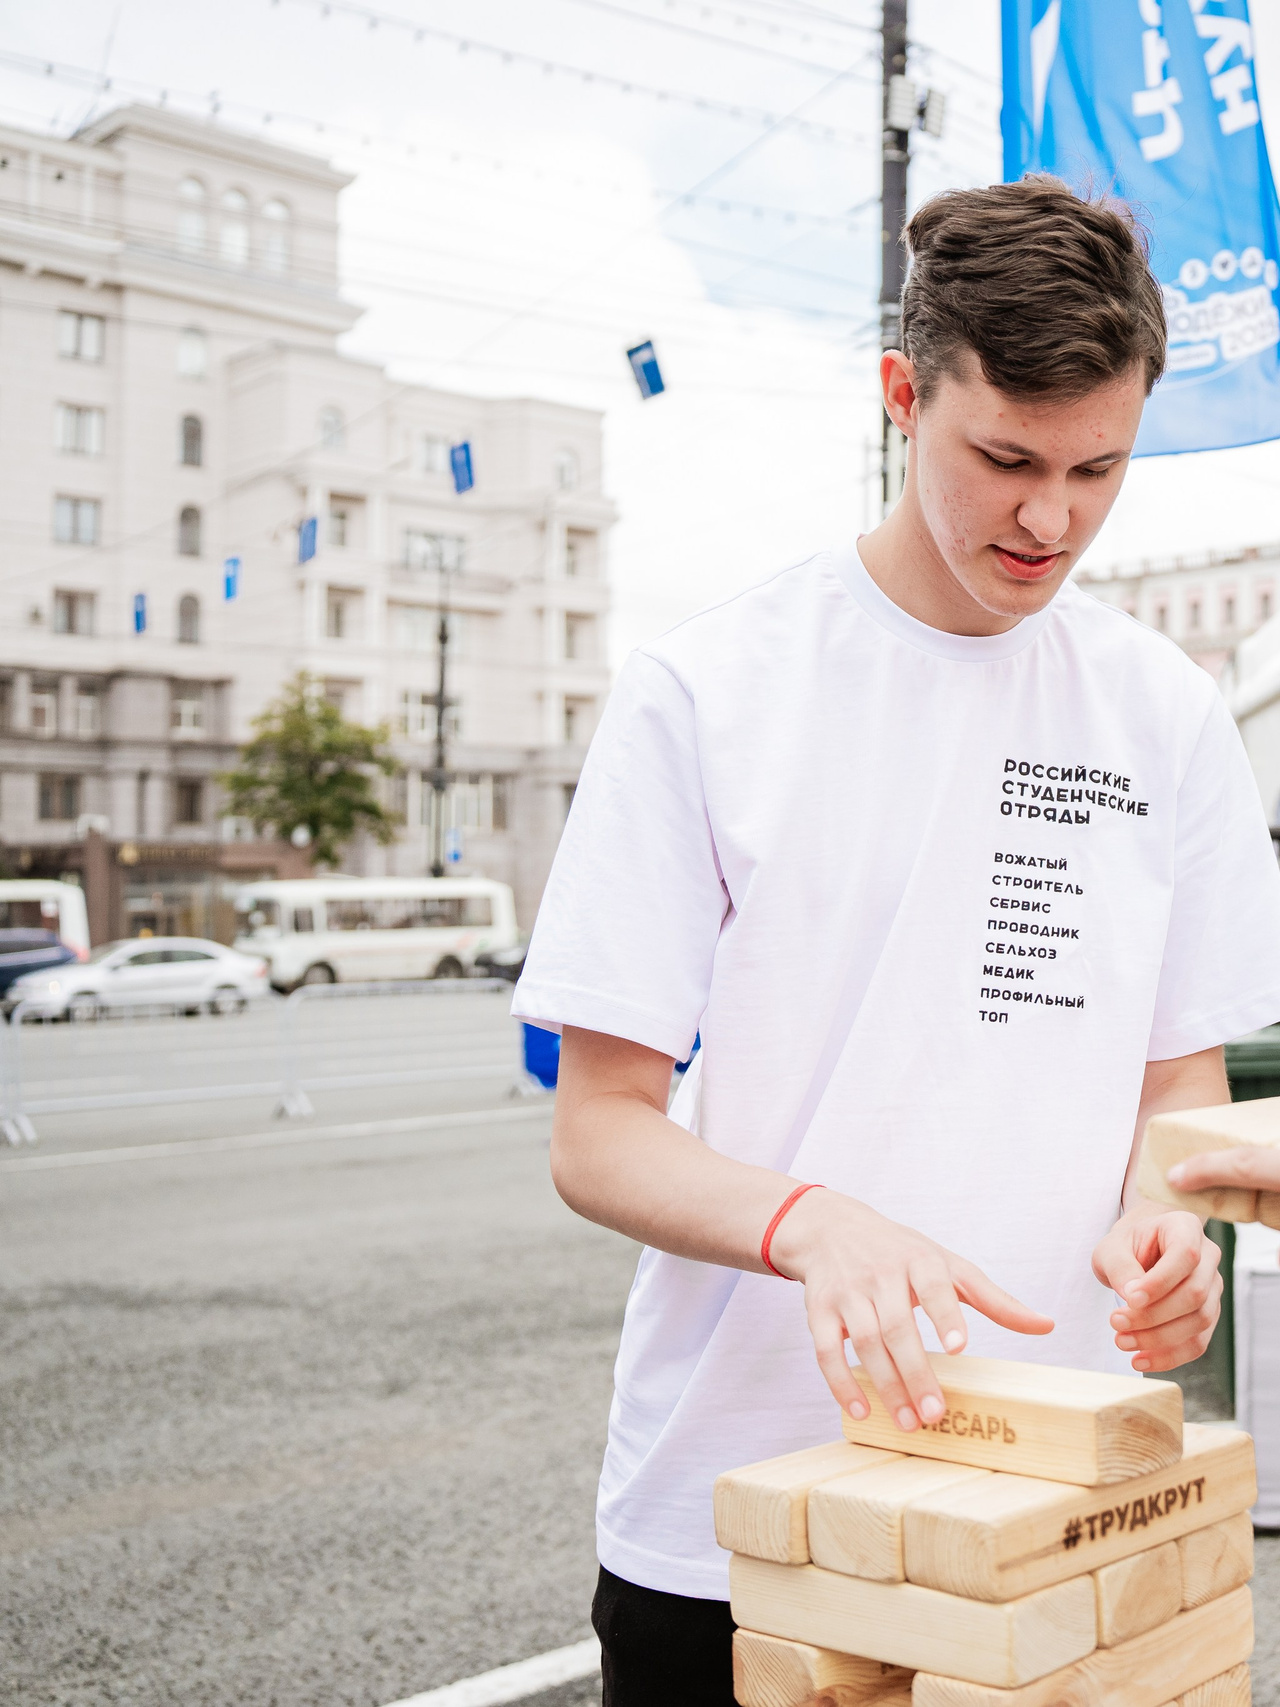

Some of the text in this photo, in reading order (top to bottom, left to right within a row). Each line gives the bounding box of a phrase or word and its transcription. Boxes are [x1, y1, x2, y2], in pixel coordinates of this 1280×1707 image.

[1003, 758, 1131, 793] РОССИЙСКИЕ
[1001, 780, 1149, 816] СТУДЕНЧЕСКИЕ
[1000, 801, 1091, 825] ОТРЯДЫ
[994, 852, 1068, 871] ВОЖАТЫЙ
[992, 875, 1084, 896] СТРОИТЕЛЬ
[989, 897, 1051, 914] СЕРВИС
[987, 919, 1080, 940] ПРОВОДНИК
[985, 942, 1057, 960] СЕЛЬХОЗ
[982, 964, 1035, 981] МЕДИК
[980, 987, 1085, 1009] ПРОФИЛЬНЫЙ
[978, 1010, 1009, 1024] ТОП
[921, 1408, 1017, 1444] ЕСАРЬ
[1062, 1476, 1206, 1551] #ТРУДКРУТ
